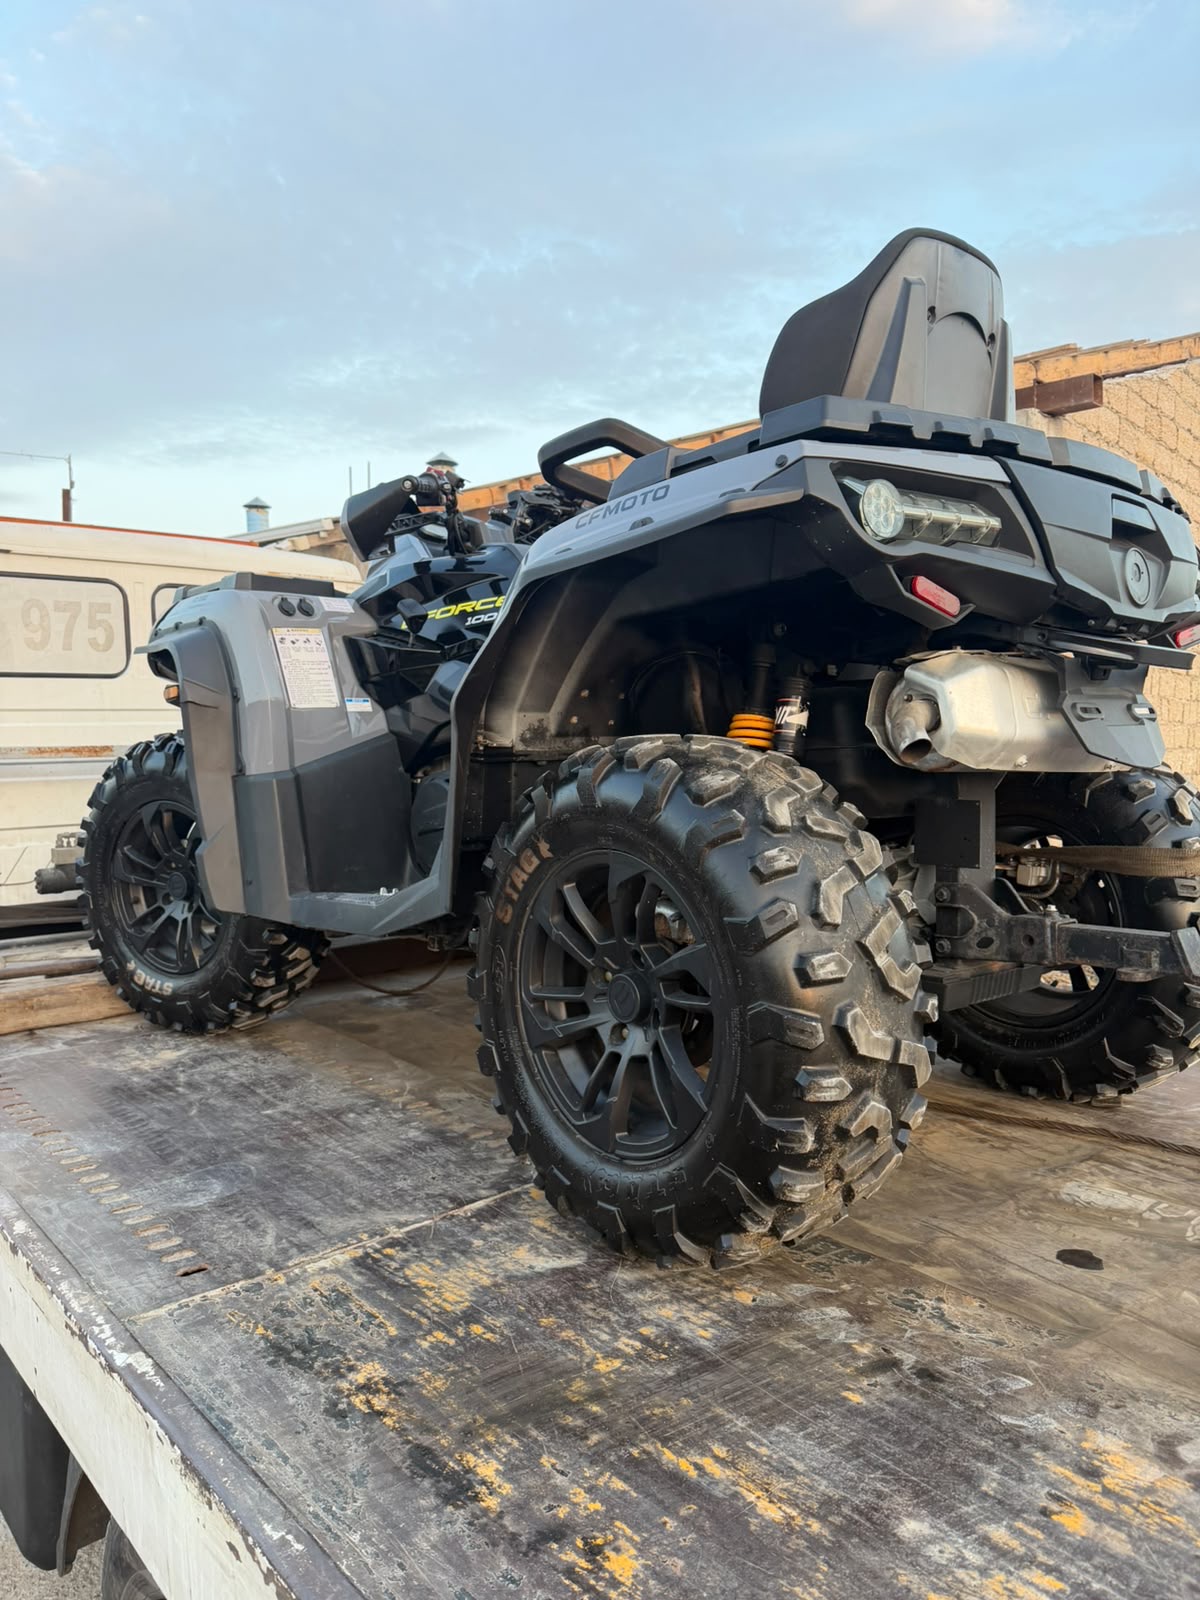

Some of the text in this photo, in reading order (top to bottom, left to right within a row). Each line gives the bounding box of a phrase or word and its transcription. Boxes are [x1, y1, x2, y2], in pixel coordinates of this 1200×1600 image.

[575, 484, 671, 530] CFMOTO
[21, 598, 115, 653] 975
[495, 847, 542, 925] STAG
[133, 969, 174, 996] STAG
